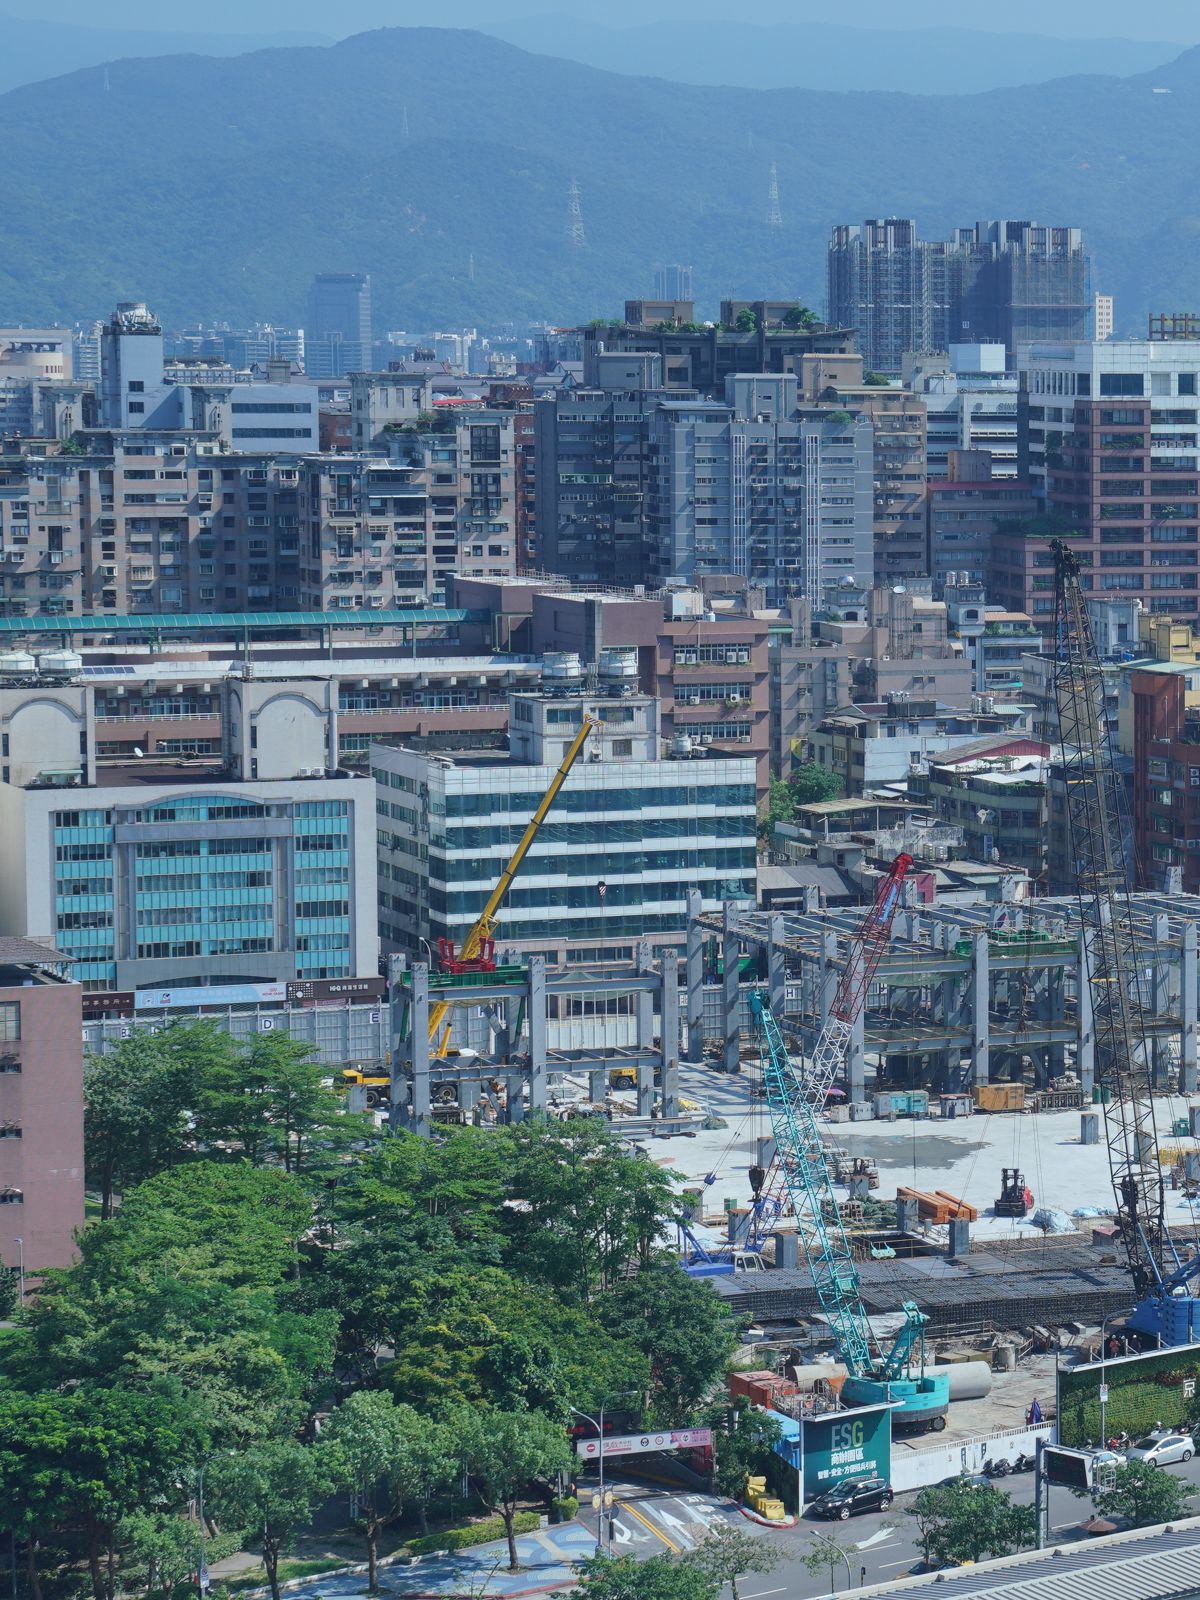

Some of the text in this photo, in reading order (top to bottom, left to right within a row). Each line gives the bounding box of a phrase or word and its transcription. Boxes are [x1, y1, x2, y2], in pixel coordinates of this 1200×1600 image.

[263, 1020, 272, 1029] D
[1183, 1377, 1197, 1398] 京
[831, 1421, 864, 1452] ESG
